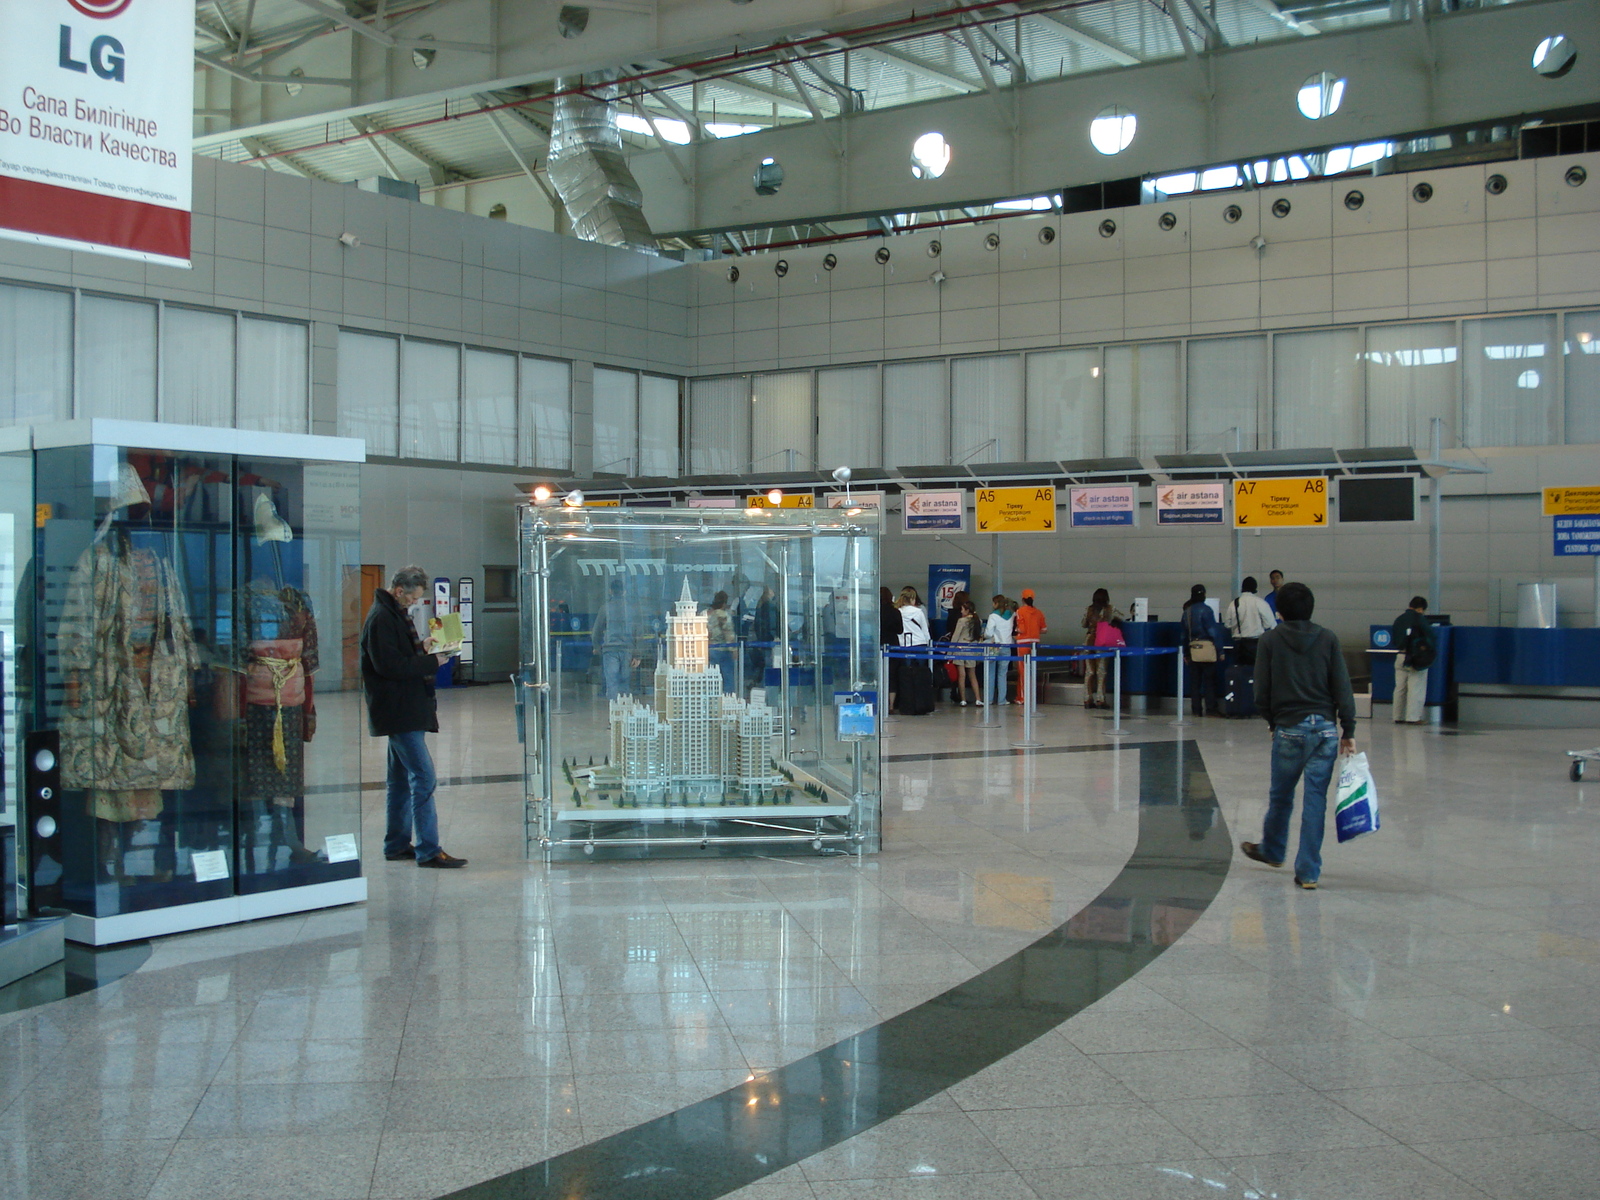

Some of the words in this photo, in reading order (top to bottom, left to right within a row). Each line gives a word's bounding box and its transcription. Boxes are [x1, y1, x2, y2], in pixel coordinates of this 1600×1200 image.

[59, 23, 126, 84] LG
[23, 86, 68, 117] Сапа
[75, 98, 158, 139] Билігінде
[0, 109, 21, 135] Во
[30, 115, 93, 150] Власти
[100, 131, 178, 169] Качества
[93, 177, 116, 190] Товар
[1237, 482, 1257, 495] A7
[1303, 480, 1324, 493] A8
[978, 490, 995, 503] A5
[1034, 489, 1052, 501] A6
[1089, 495, 1100, 503] air
[1102, 495, 1130, 503] astana
[1176, 491, 1188, 499] air
[750, 498, 765, 508] A3
[797, 496, 812, 507] A4
[921, 499, 932, 507] air
[942, 587, 955, 599] 15
